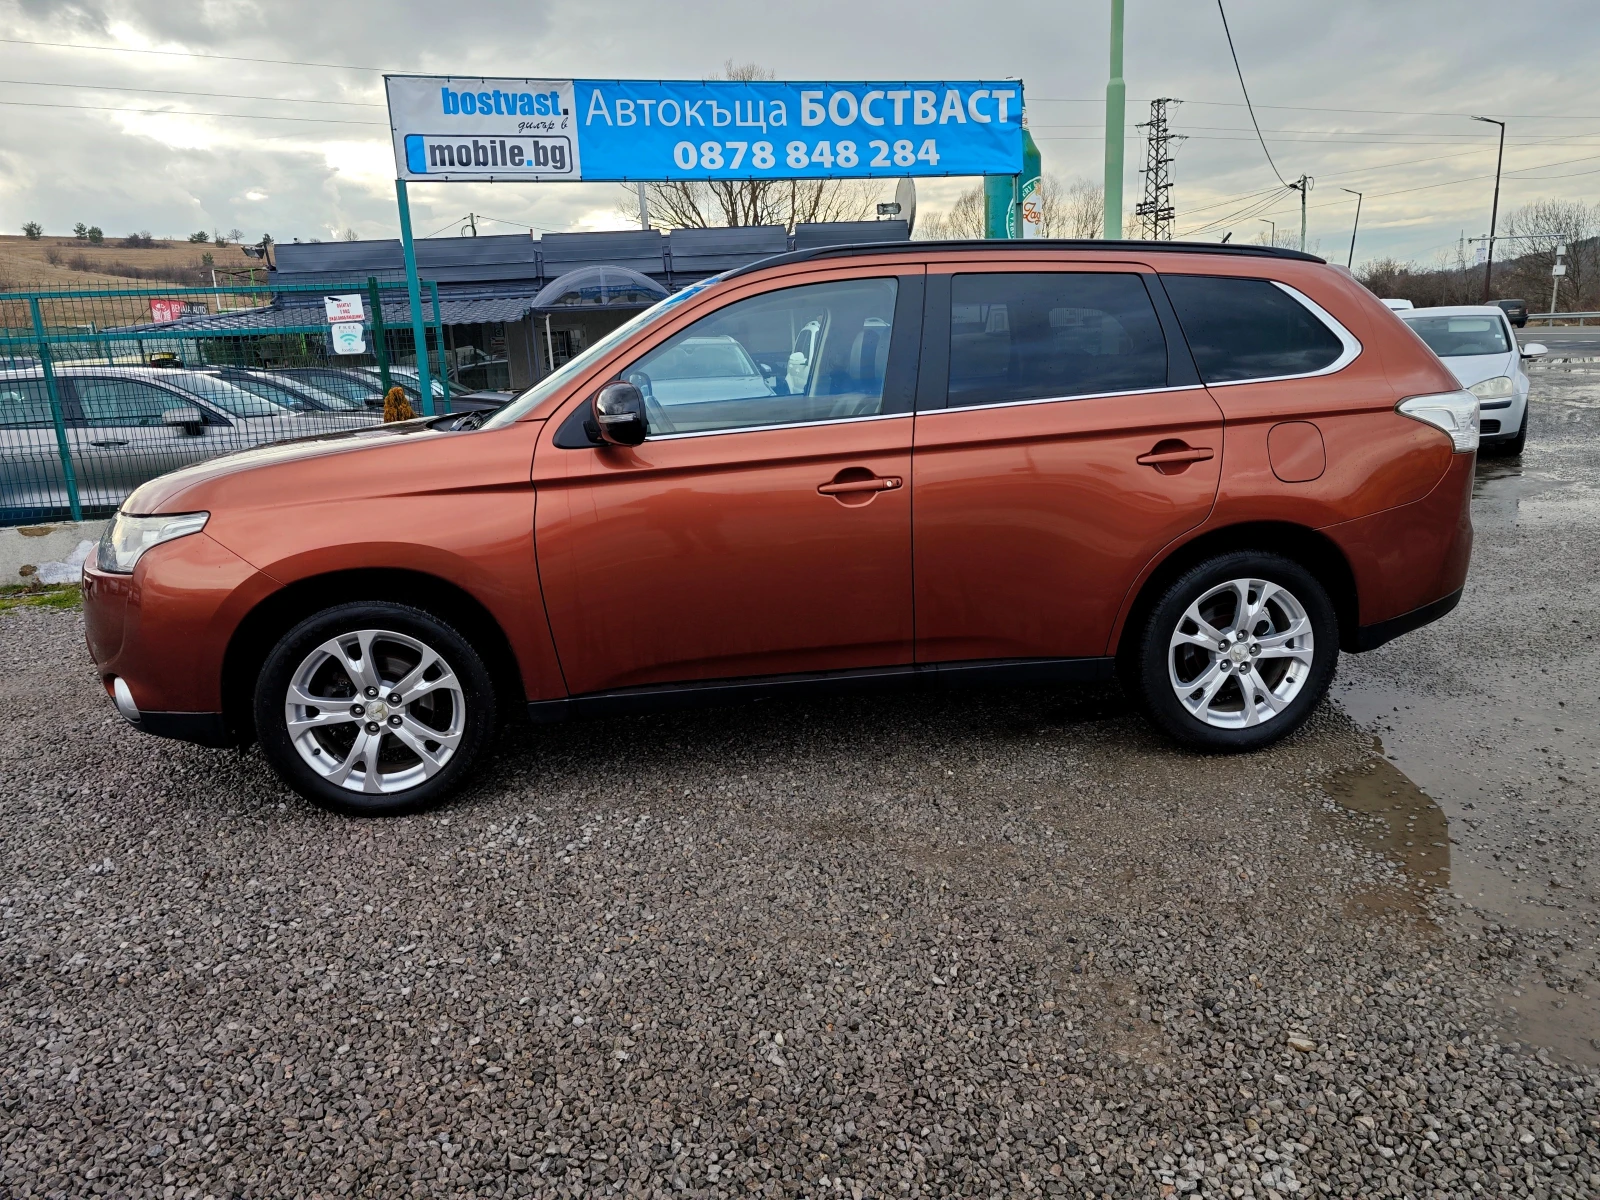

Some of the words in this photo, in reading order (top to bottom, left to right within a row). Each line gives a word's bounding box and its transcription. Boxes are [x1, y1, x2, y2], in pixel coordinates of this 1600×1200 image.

[441, 88, 569, 116] bostvast.
[585, 89, 788, 134] Автокъща
[801, 89, 1016, 126] БОСТВАСТ
[518, 120, 555, 133] дилър
[429, 140, 566, 170] mobile.bg
[673, 140, 776, 170] 0878
[786, 140, 859, 168] 848
[869, 139, 940, 167] 284
